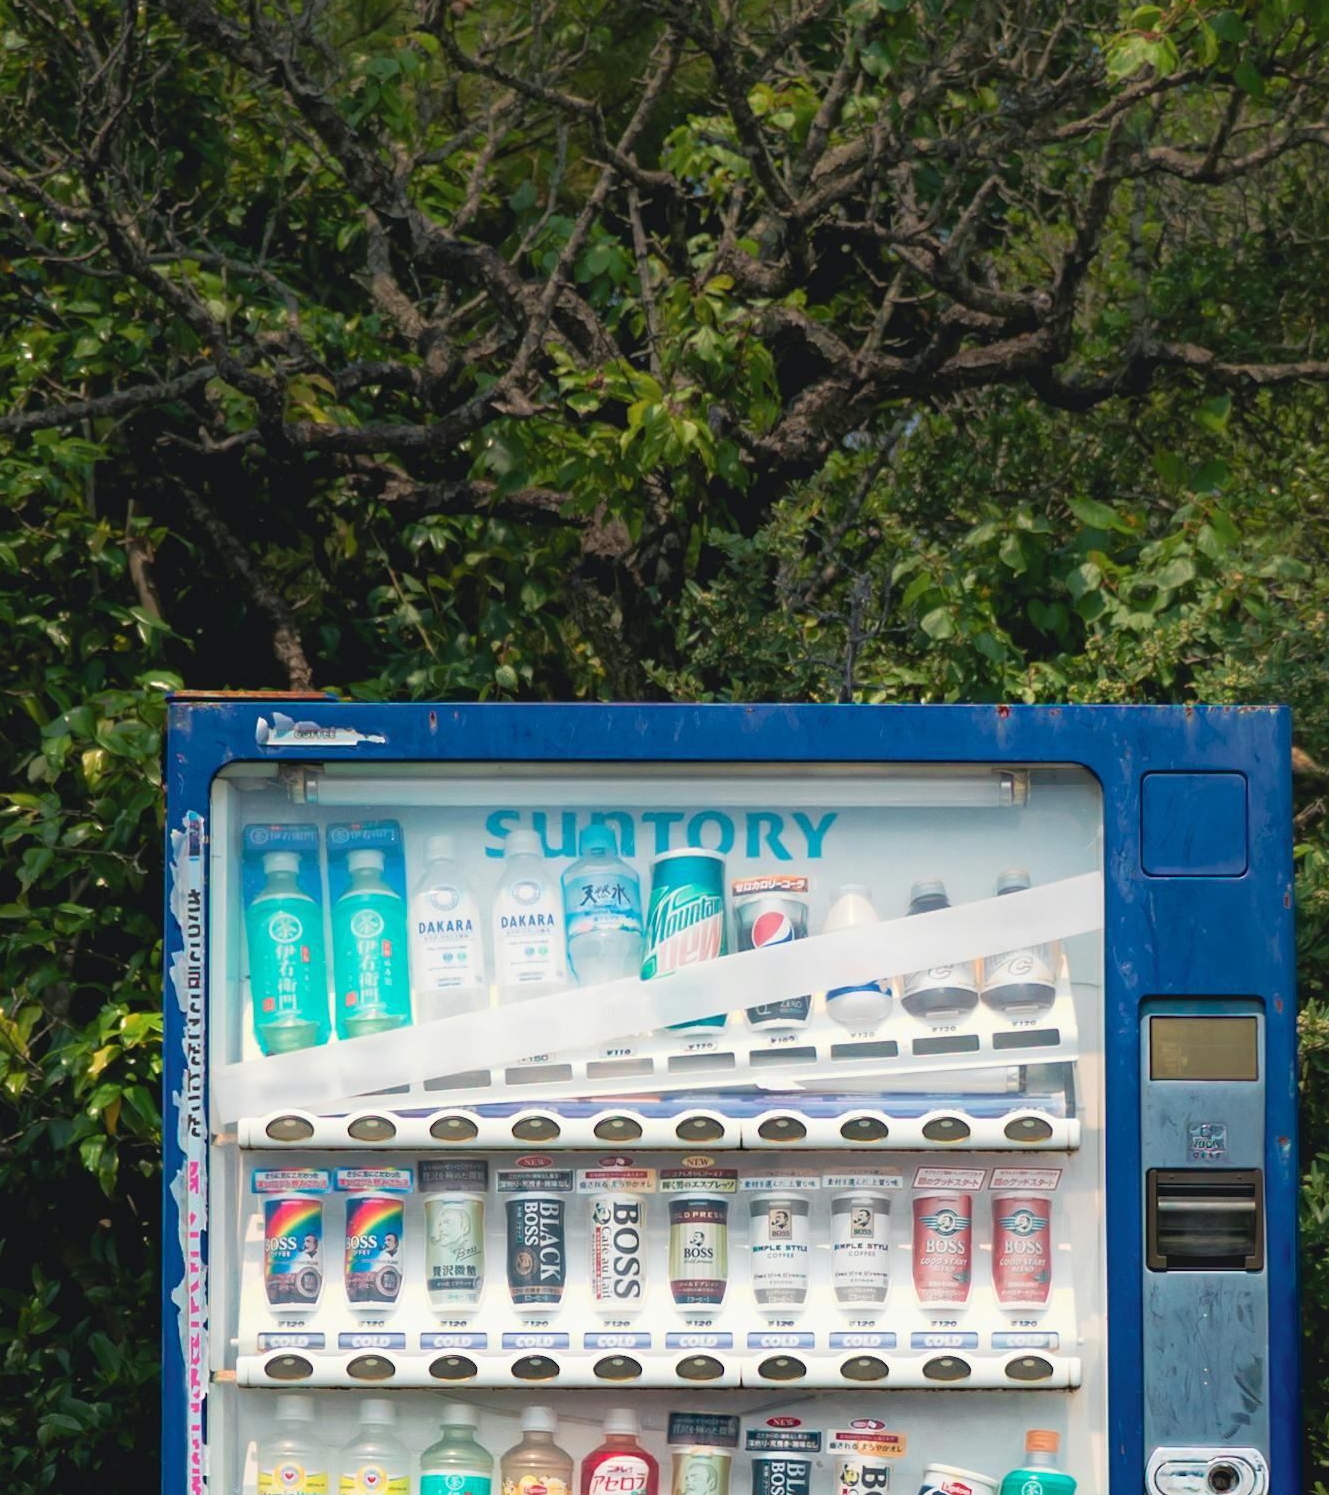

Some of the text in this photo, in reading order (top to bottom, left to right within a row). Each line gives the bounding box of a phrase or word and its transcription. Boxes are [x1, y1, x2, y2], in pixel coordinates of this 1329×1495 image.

[735, 878, 805, 893] ゼロカロリーコーラ
[580, 883, 631, 906] 天然水
[418, 918, 473, 935] DAKARA
[500, 913, 555, 929] DAKARA
[524, 1201, 539, 1247] BOSS
[540, 1201, 561, 1281] BLACK
[926, 1240, 965, 1254] BOSS
[1004, 1240, 1043, 1254] BOSS
[613, 1202, 640, 1299] BOSS
[684, 1248, 714, 1259] BOSS
[773, 1418, 794, 1426] NEW
[593, 1473, 646, 1493] アセロラ
